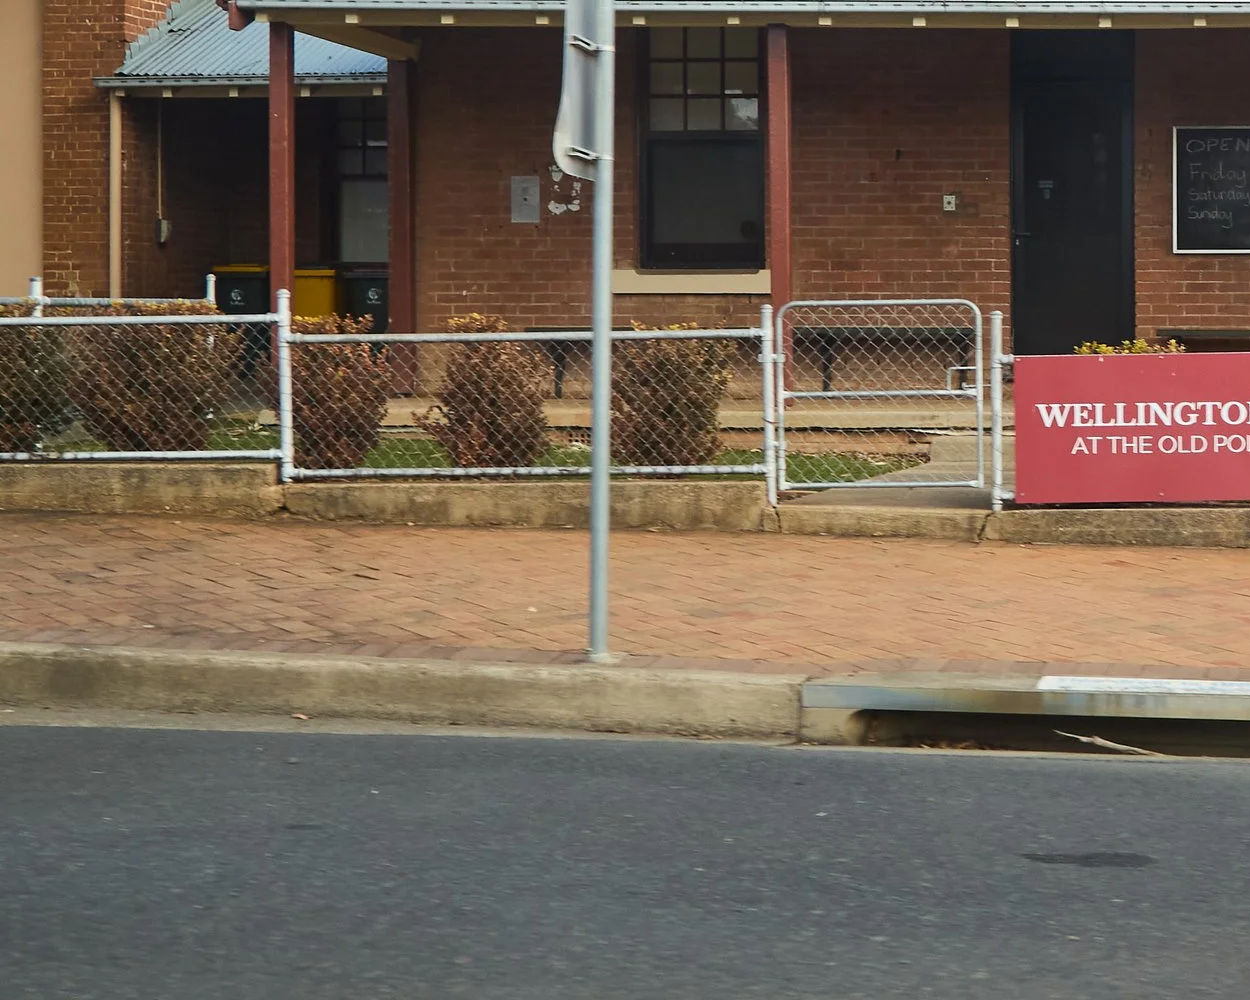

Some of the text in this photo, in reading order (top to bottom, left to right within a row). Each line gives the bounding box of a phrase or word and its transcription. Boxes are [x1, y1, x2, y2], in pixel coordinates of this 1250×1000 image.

[1188, 161, 1247, 188] Friday
[1187, 205, 1233, 228] Sunday
[1071, 436, 1103, 455] AT
[1106, 436, 1153, 454] THE
[1158, 435, 1208, 454] OLD
